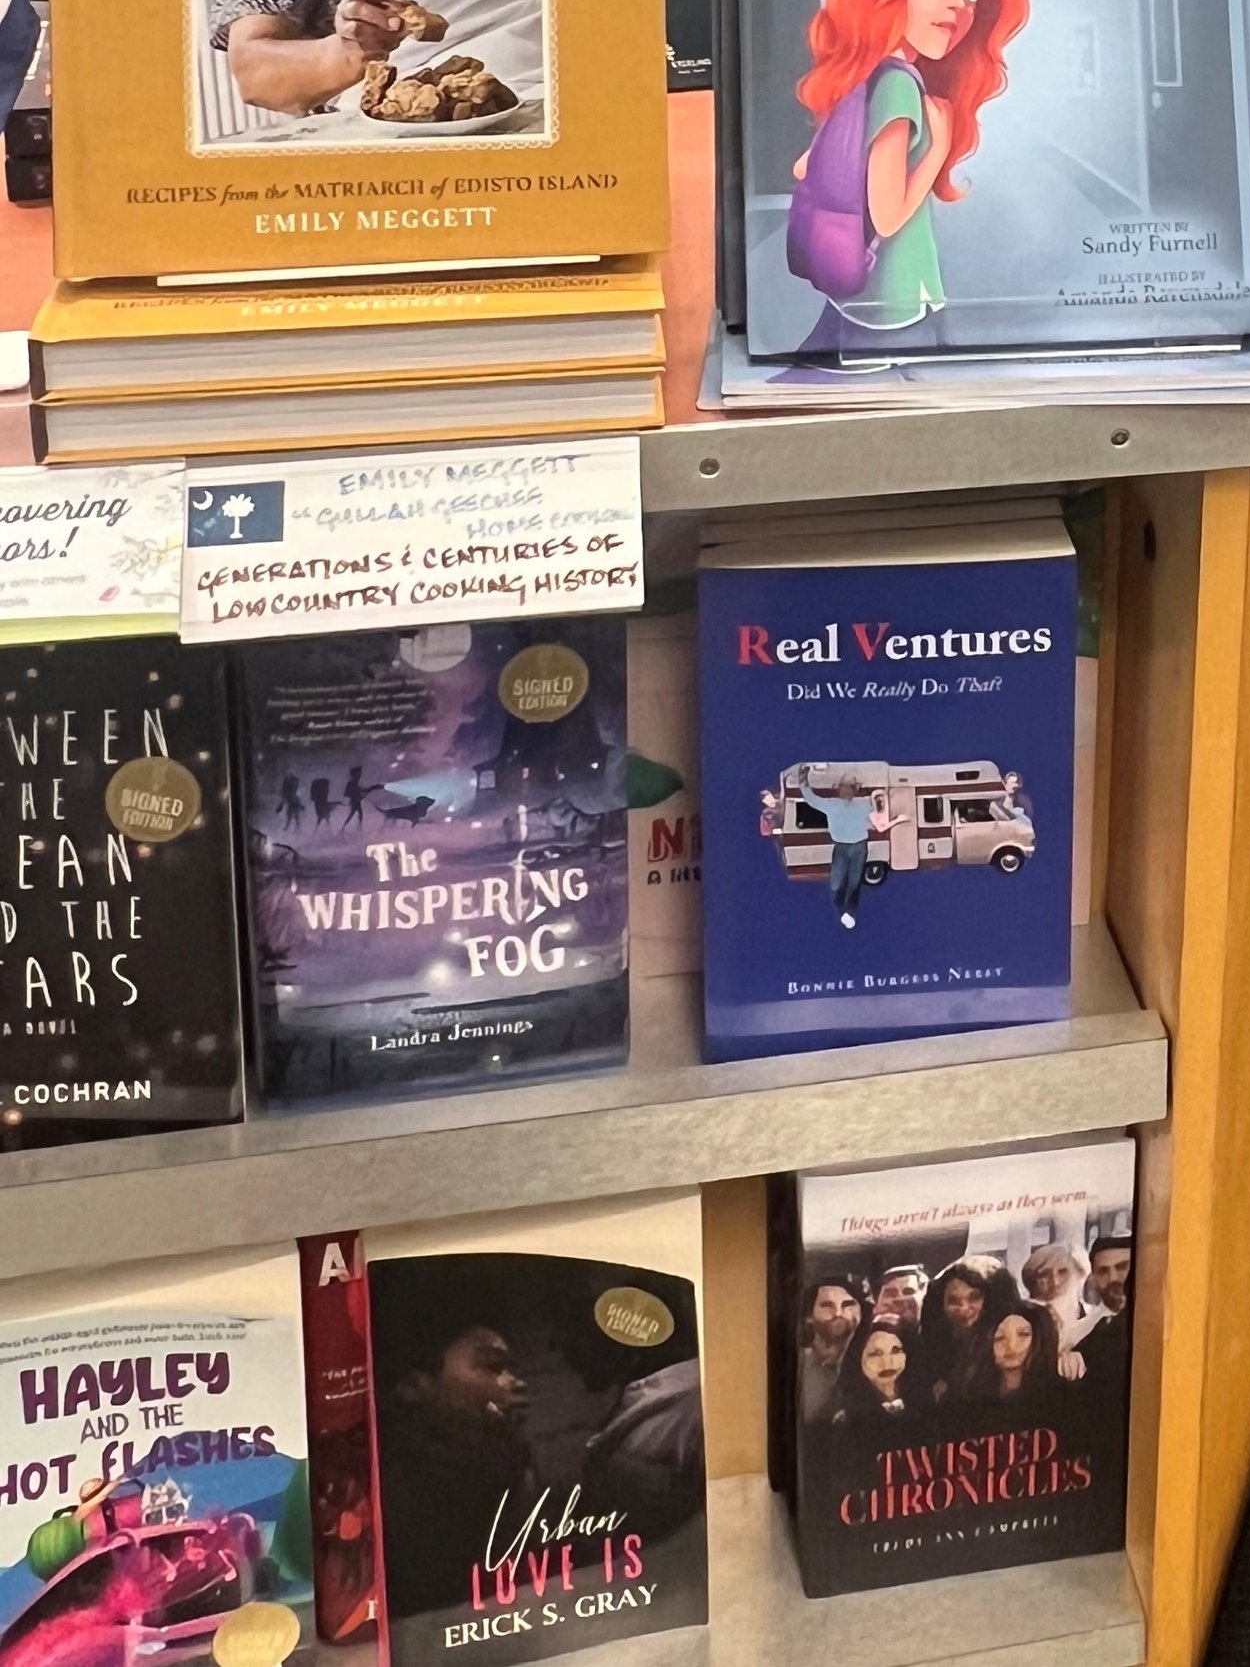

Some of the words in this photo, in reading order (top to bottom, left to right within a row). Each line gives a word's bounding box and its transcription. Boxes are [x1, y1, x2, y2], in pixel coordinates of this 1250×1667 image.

[126, 185, 217, 205] RECIPES
[219, 183, 260, 206] from
[264, 182, 290, 202] the
[294, 179, 425, 199] MATRIARCH
[429, 176, 449, 199] of
[454, 175, 532, 195] EDISTO
[538, 173, 618, 191] ISLAND
[255, 210, 343, 235] EMILY
[356, 207, 497, 232] MEGGETT
[1082, 235, 1143, 257] Sandy
[1149, 232, 1218, 252] Furnell
[339, 465, 436, 495] EMILY
[197, 551, 394, 593] GENERATIONS
[422, 535, 580, 570] CENTURIES
[587, 533, 625, 555] OF
[410, 572, 528, 605] COOKING
[534, 562, 638, 593] HISTORY
[736, 623, 841, 666] Real
[852, 621, 1053, 663] Ventures
[512, 676, 574, 697] SIGNED
[787, 682, 821, 701] Did
[827, 681, 856, 700] We
[862, 681, 916, 703] Really
[921, 678, 949, 697] Do
[0, 778, 66, 821] HE
[121, 788, 184, 817] SIGNED
[366, 841, 439, 884] The
[60, 896, 142, 940] THE
[299, 862, 590, 933] WHISPERING
[466, 928, 567, 978] FOG
[0, 951, 138, 1009] ARS
[370, 1028, 441, 1053] Landra
[447, 1019, 534, 1042] Jennings
[14, 1080, 151, 1105] COCHRAN
[1016, 1193, 1047, 1210] they
[21, 1352, 231, 1424] HAYLEY
[81, 1409, 130, 1444] AND
[140, 1403, 185, 1431] THE
[0, 1452, 76, 1506] HOT
[101, 1424, 276, 1484] FLASHES
[877, 1427, 1058, 1487] TWISTED
[840, 1454, 1092, 1527] CHRONICLES
[485, 1482, 628, 1573] Urban
[472, 1554, 574, 1611] LOVE
[603, 1533, 643, 1584] IS
[444, 1609, 531, 1650] ERICK
[541, 1603, 566, 1628] S.
[574, 1584, 657, 1620] GRAY
